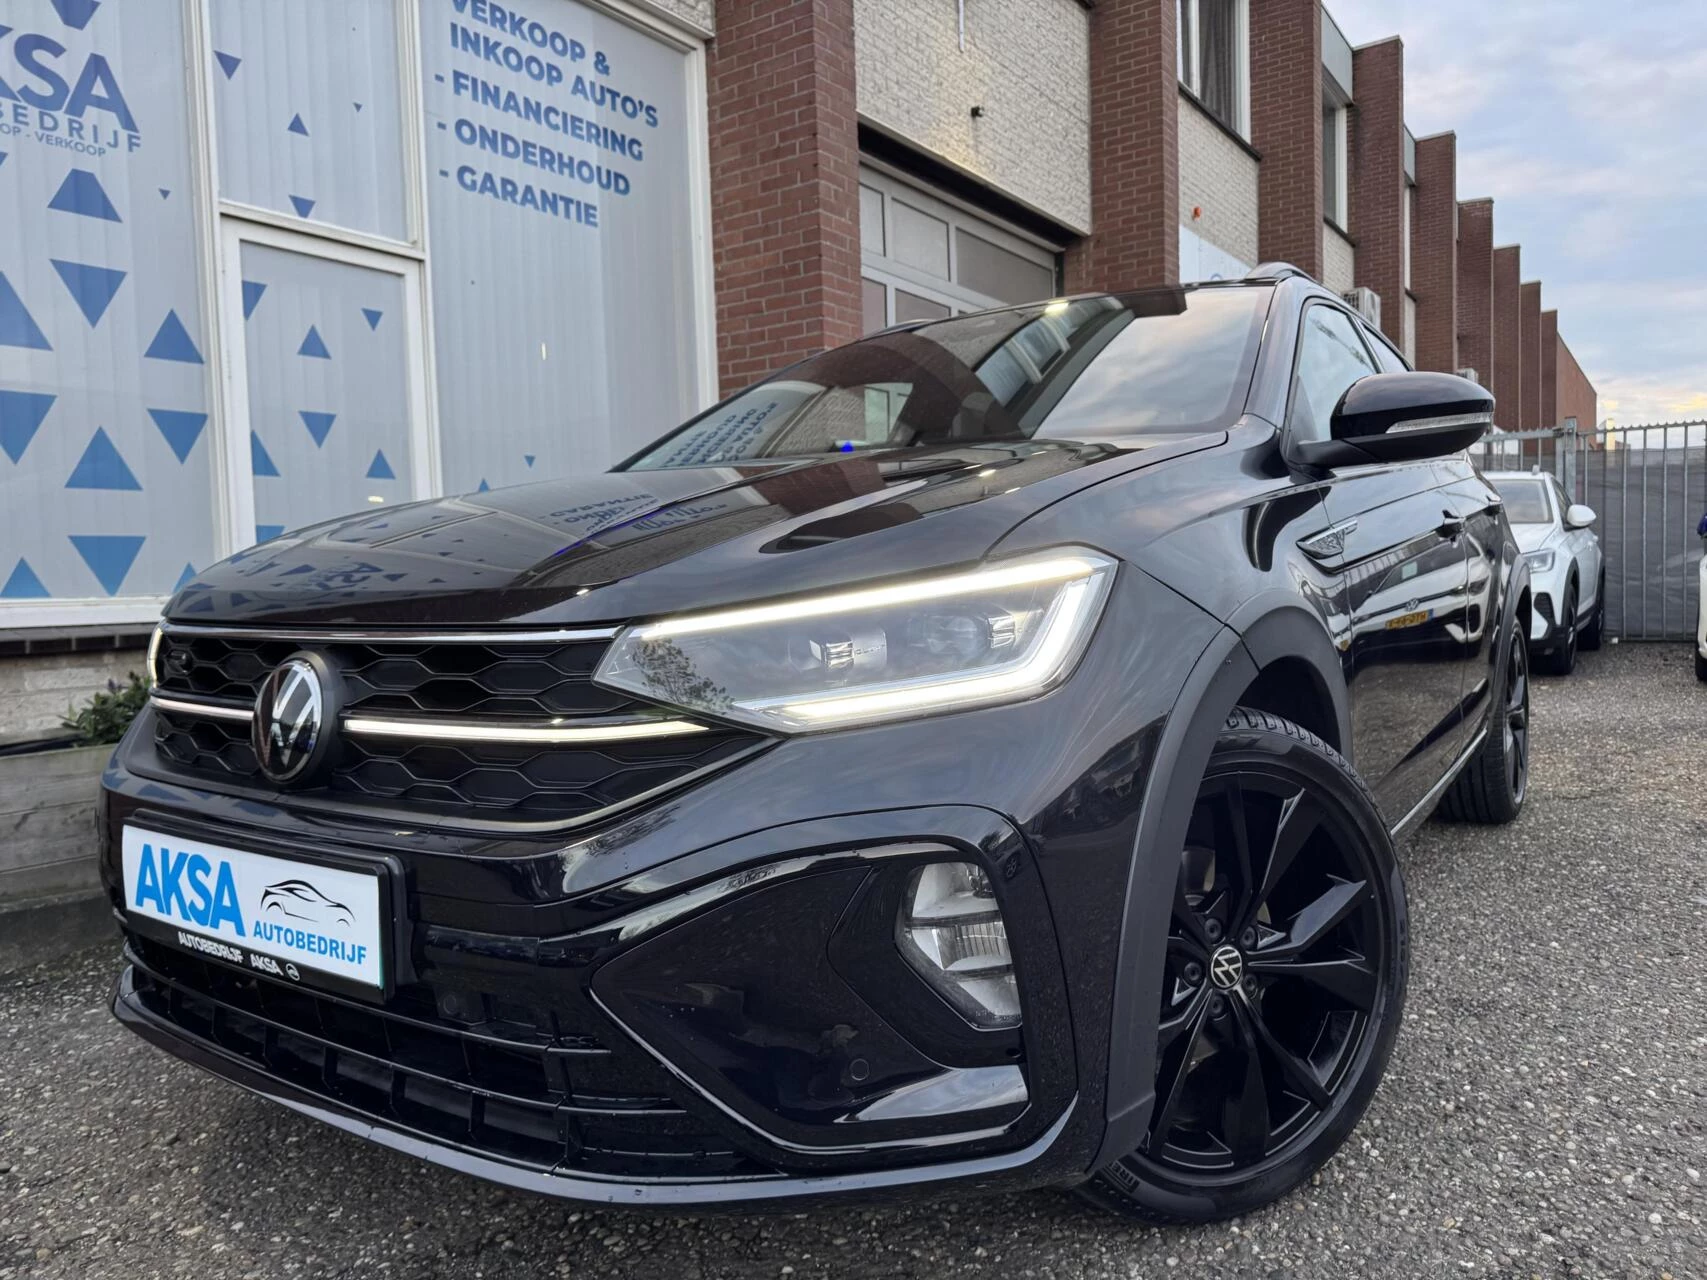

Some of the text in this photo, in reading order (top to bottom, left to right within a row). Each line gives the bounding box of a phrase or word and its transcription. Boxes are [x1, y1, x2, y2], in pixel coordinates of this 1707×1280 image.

[450, 22, 658, 128] INKOOP AUTO'S
[594, 51, 611, 77] &
[0, 102, 141, 153] EDRIJF
[35, 130, 107, 157] VERKOOP
[452, 69, 643, 162] FINANCIERING
[454, 118, 630, 196] ONDERHOUD
[457, 165, 599, 228] GARANTIE
[135, 843, 246, 938] AKSA
[178, 931, 284, 977] AUTOBEDRIJF AKSA
[253, 920, 367, 965] AUTOBEDRIJF
